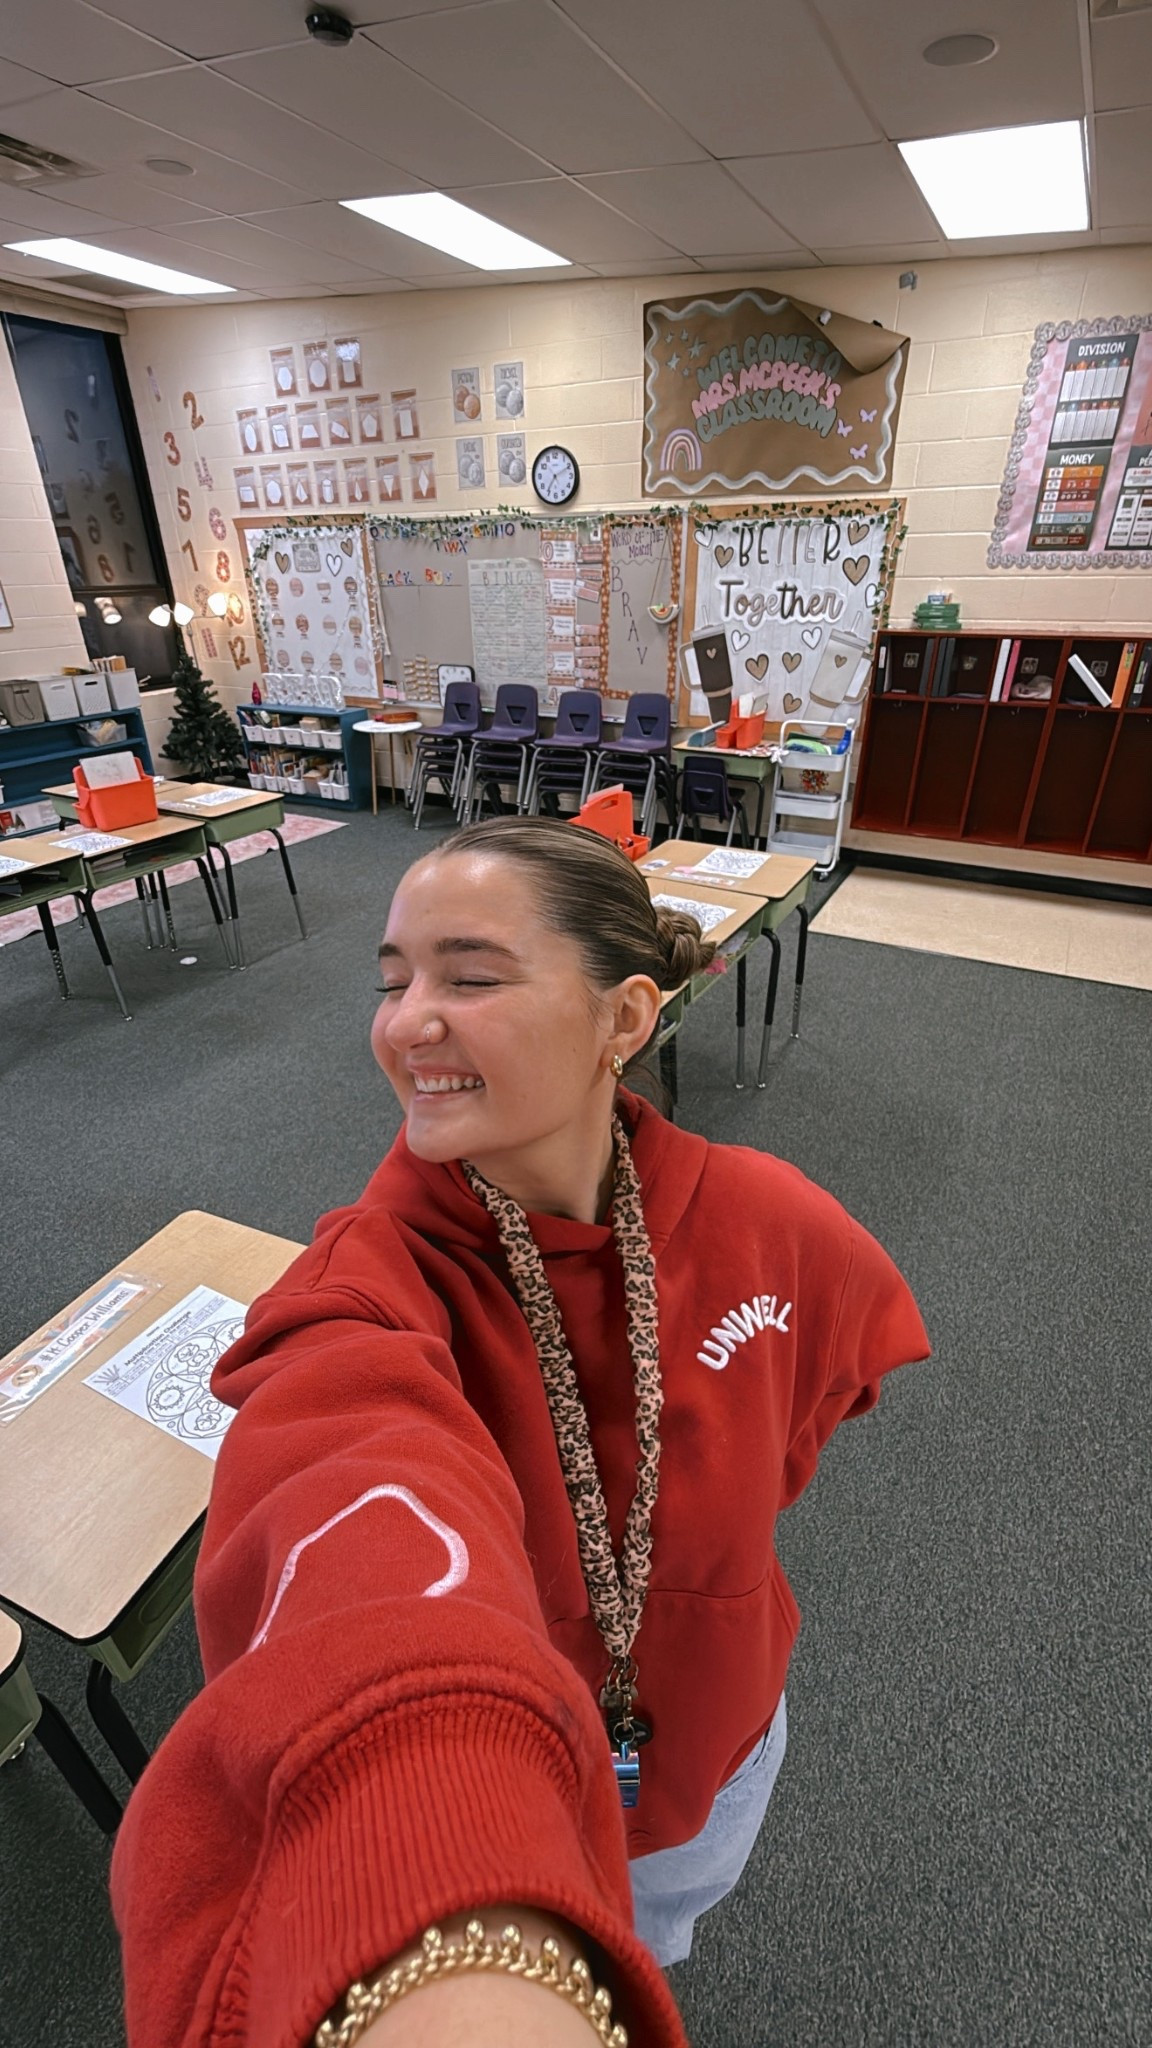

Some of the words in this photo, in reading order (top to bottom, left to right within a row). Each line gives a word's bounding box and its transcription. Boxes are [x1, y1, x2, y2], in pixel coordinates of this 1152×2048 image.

[697, 332, 812, 391] WELCOME
[1077, 341, 1127, 357] DIVISION
[183, 391, 204, 430] 2
[696, 387, 838, 444] CLASSROOM
[163, 431, 181, 466] 3
[1059, 453, 1095, 465] MONEY
[194, 456, 213, 491] 4
[176, 486, 192, 522] 5
[208, 507, 227, 541] 6
[611, 530, 632, 547] WORD
[635, 531, 645, 544] OF
[181, 539, 198, 572] 7
[739, 522, 841, 567] BETTER
[216, 550, 230, 583] 8
[482, 570, 533, 586] BINGO
[719, 579, 844, 628] Together
[227, 635, 251, 671] 12
[57, 1322, 91, 1347] Cooper
[84, 1290, 129, 1321] Williams
[696, 1294, 792, 1371] UNWELL
[124, 1333, 165, 1367] Multiplication
[163, 1311, 191, 1333] Challenge
